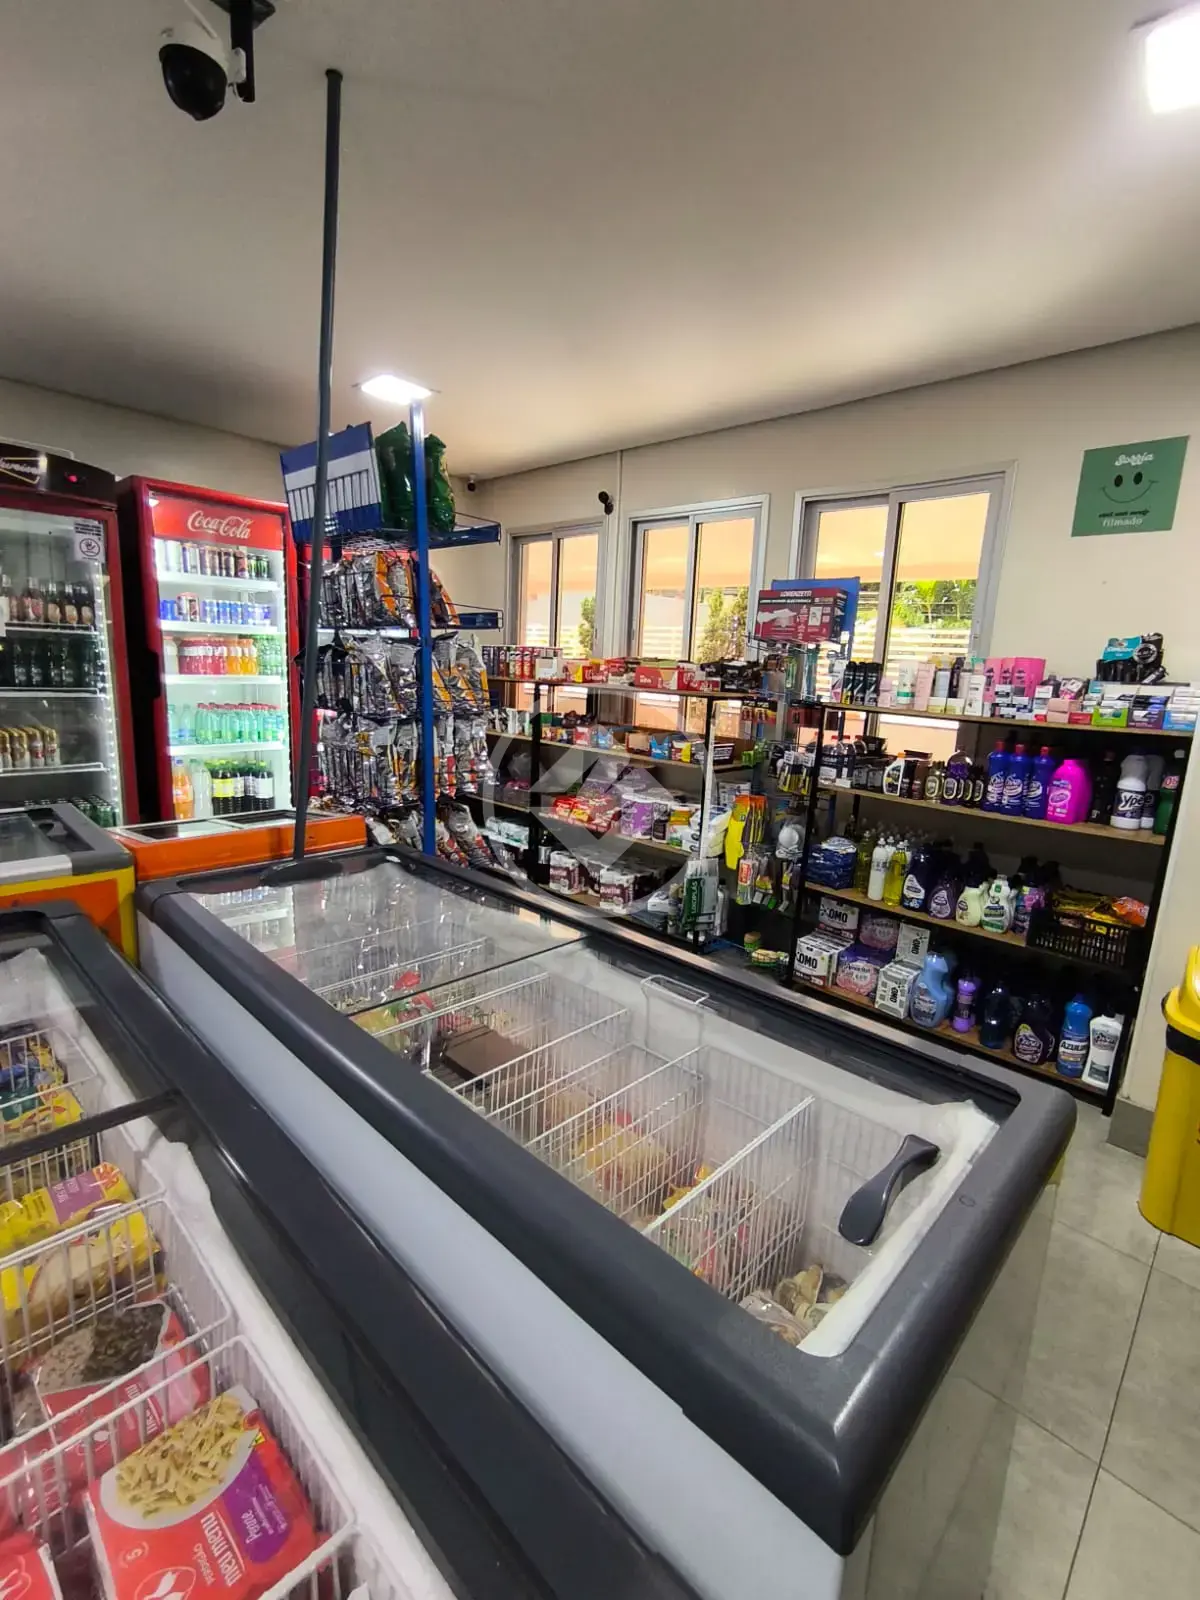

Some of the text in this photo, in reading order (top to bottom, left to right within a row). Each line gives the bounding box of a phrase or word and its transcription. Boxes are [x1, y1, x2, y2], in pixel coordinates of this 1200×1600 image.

[187, 510, 253, 539] Coca-Cola
[828, 908, 848, 923] OMO
[798, 952, 818, 969] OMO
[201, 1511, 243, 1587] meu menu
